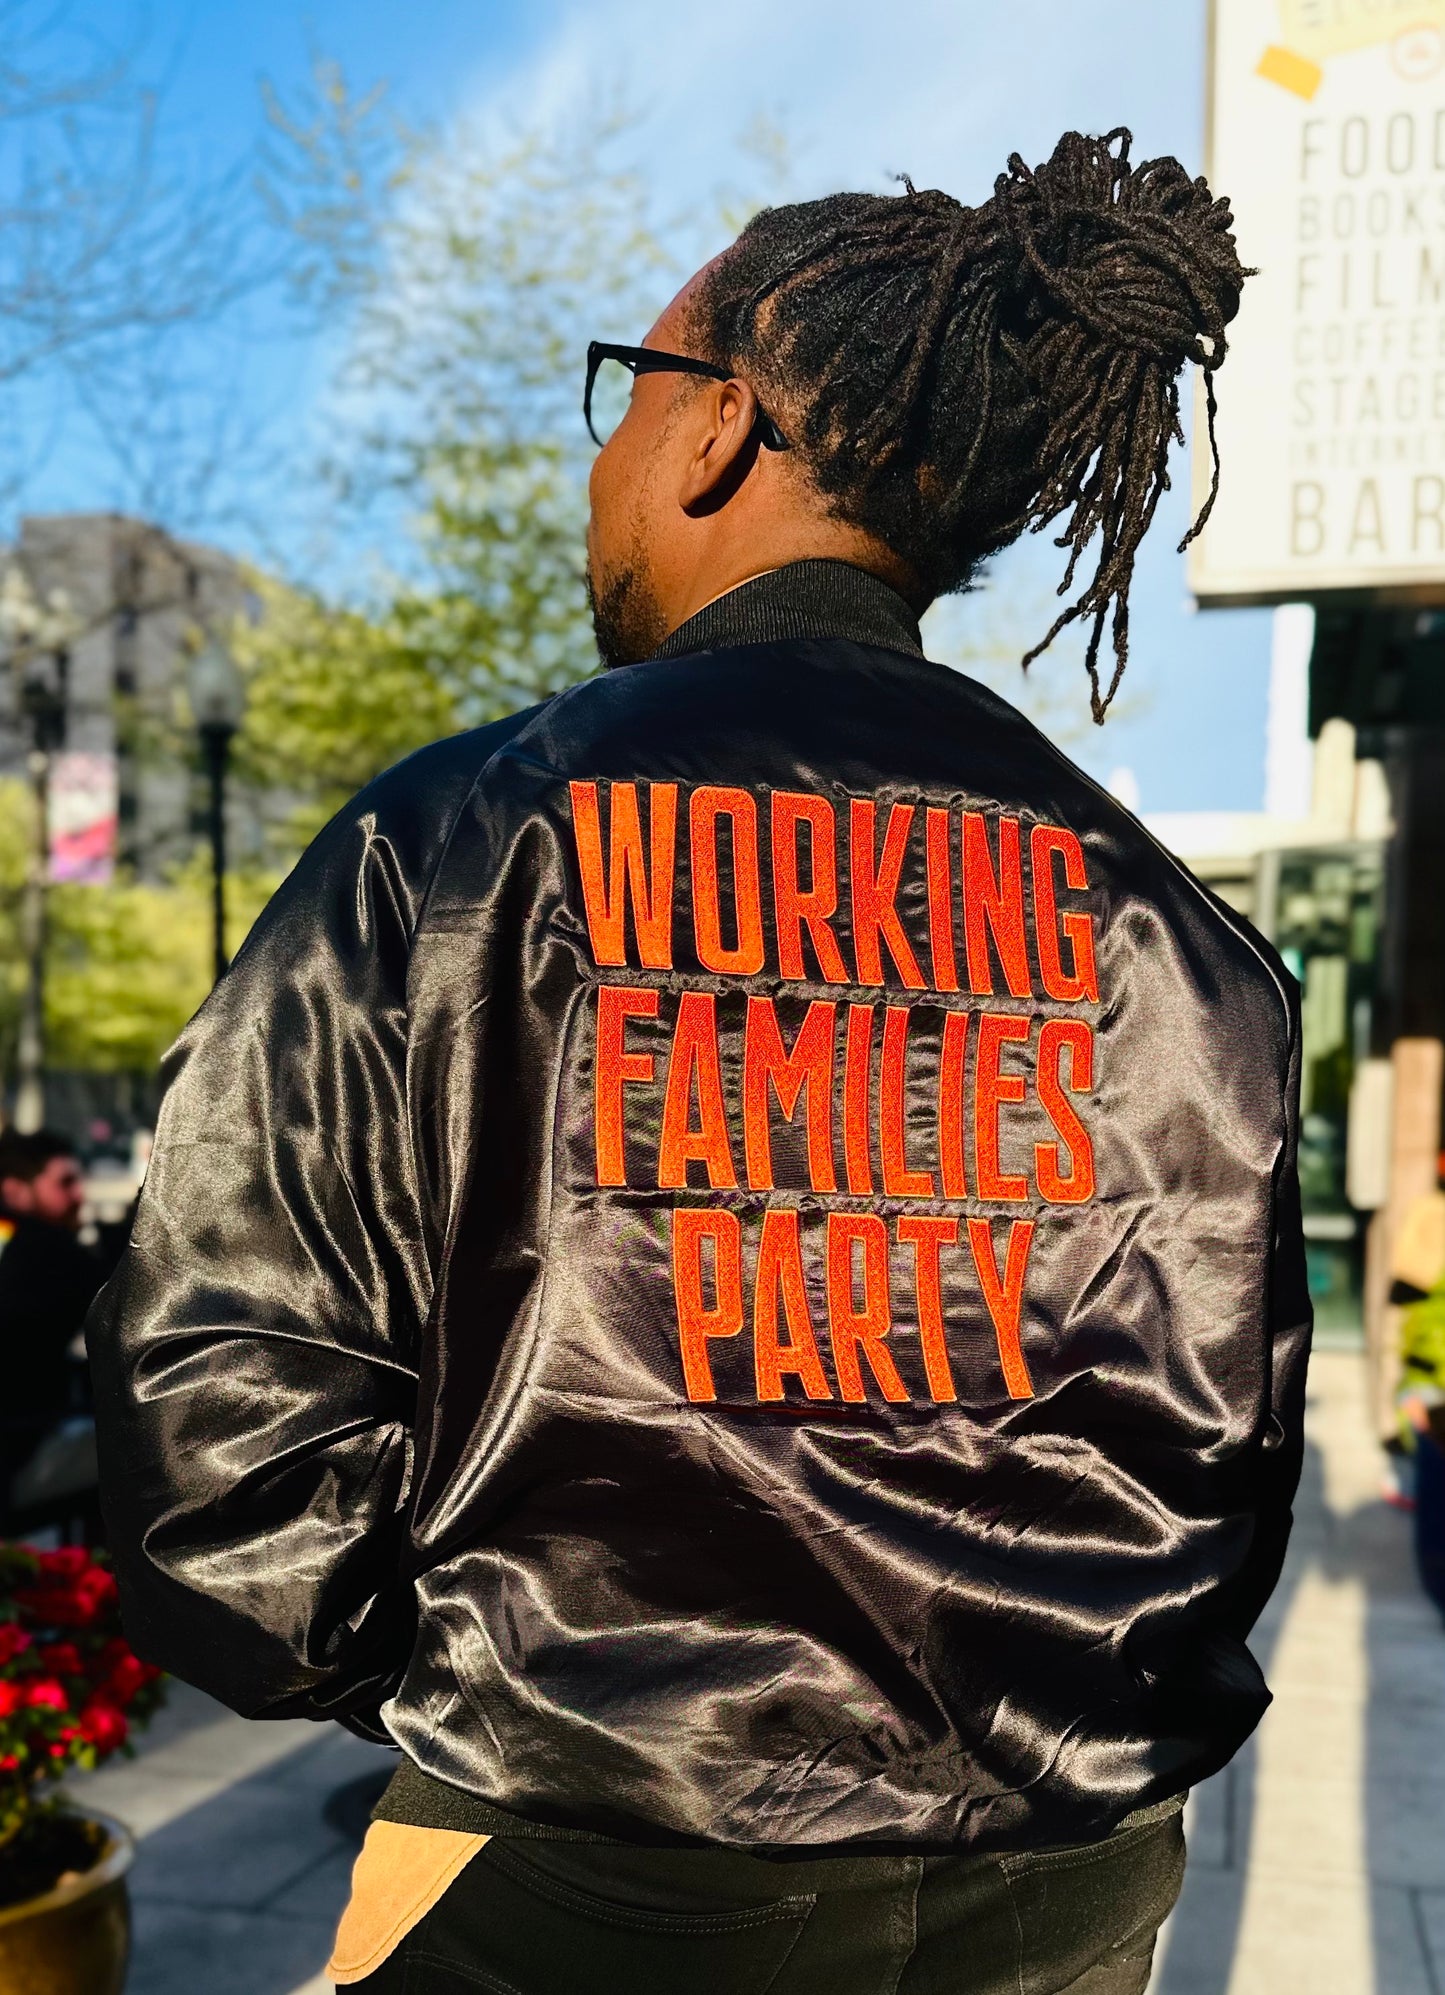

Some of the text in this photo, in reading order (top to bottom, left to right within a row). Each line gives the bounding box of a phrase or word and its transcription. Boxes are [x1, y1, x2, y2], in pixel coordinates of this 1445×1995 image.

[1289, 473, 1445, 558] BAR
[569, 780, 1099, 1003] WORKING
[596, 984, 1096, 1203] FAMILIES
[672, 1207, 1036, 1403] PARTY
